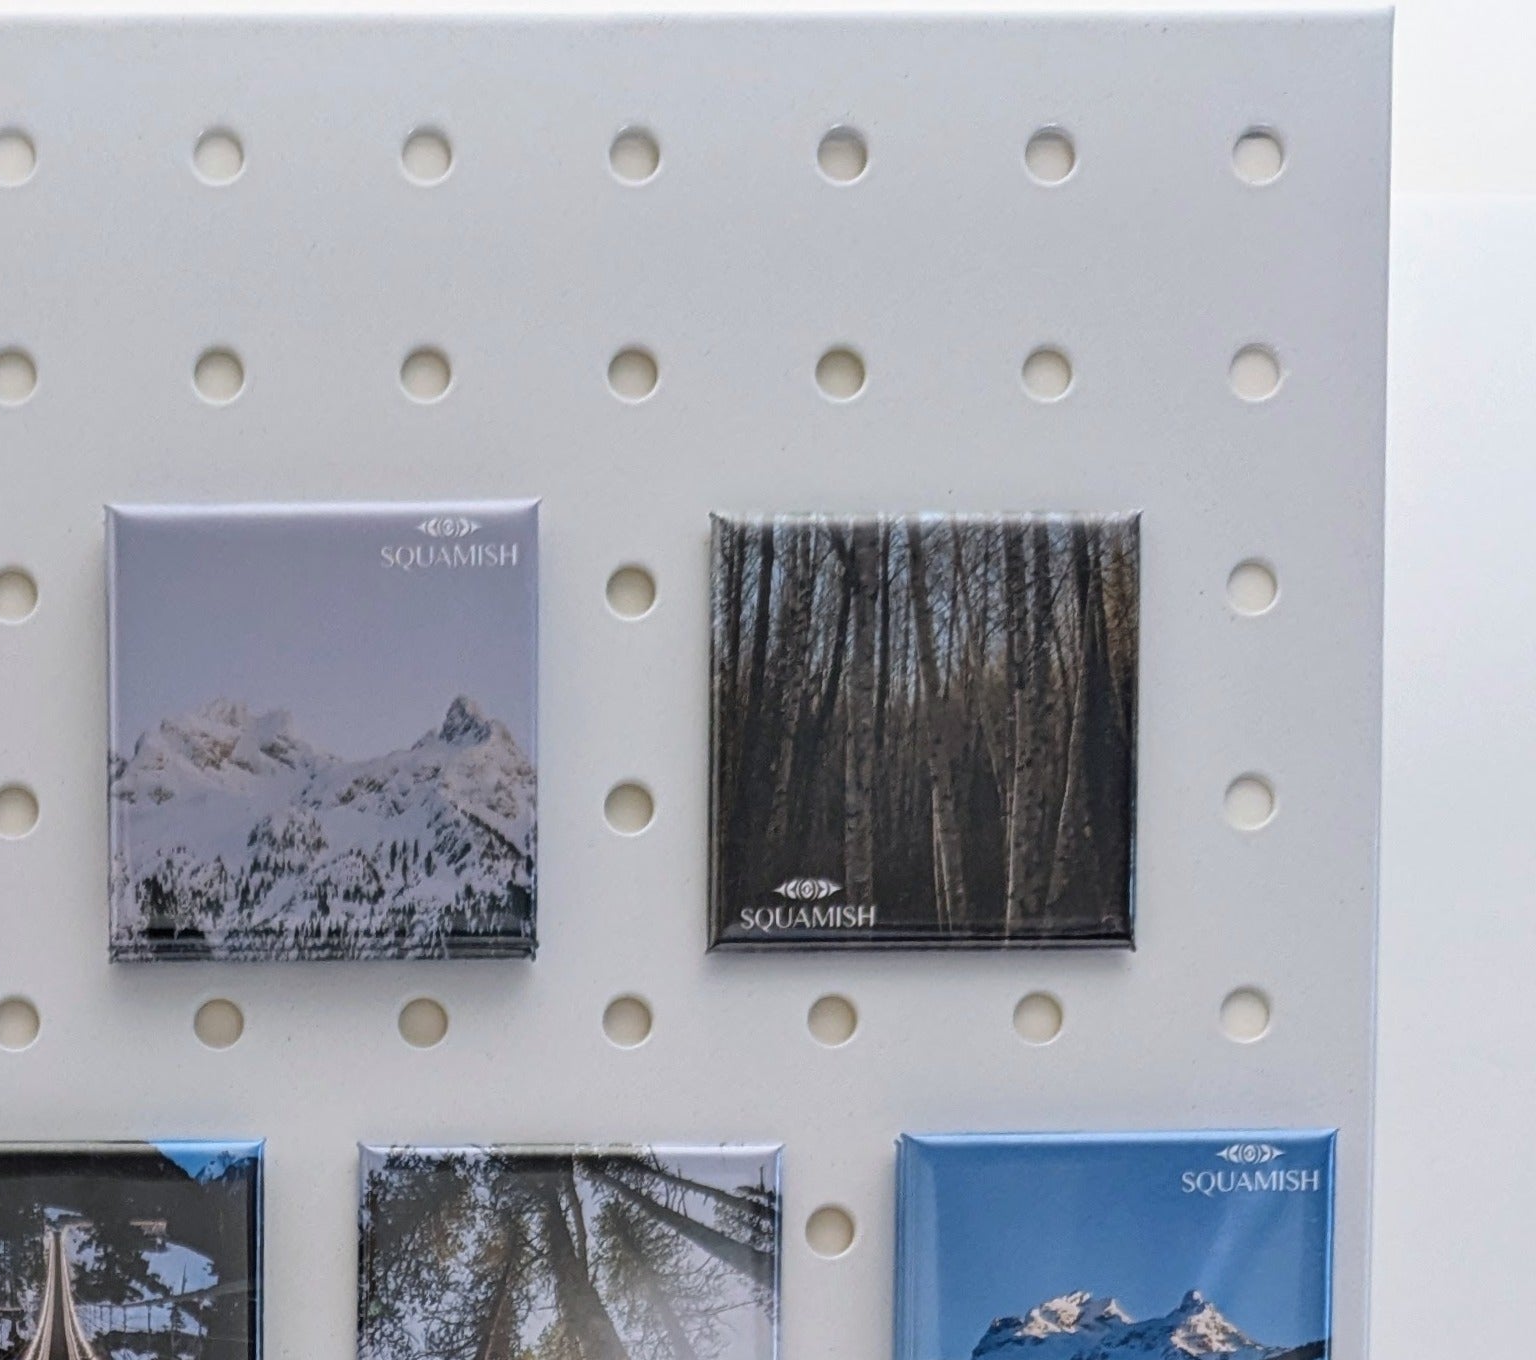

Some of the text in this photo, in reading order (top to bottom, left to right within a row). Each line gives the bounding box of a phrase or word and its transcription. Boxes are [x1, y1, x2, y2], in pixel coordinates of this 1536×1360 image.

[380, 543, 518, 571] SQUAMISH
[739, 905, 876, 933] SQUAMISH
[1181, 1169, 1319, 1196] SQUAMISH
